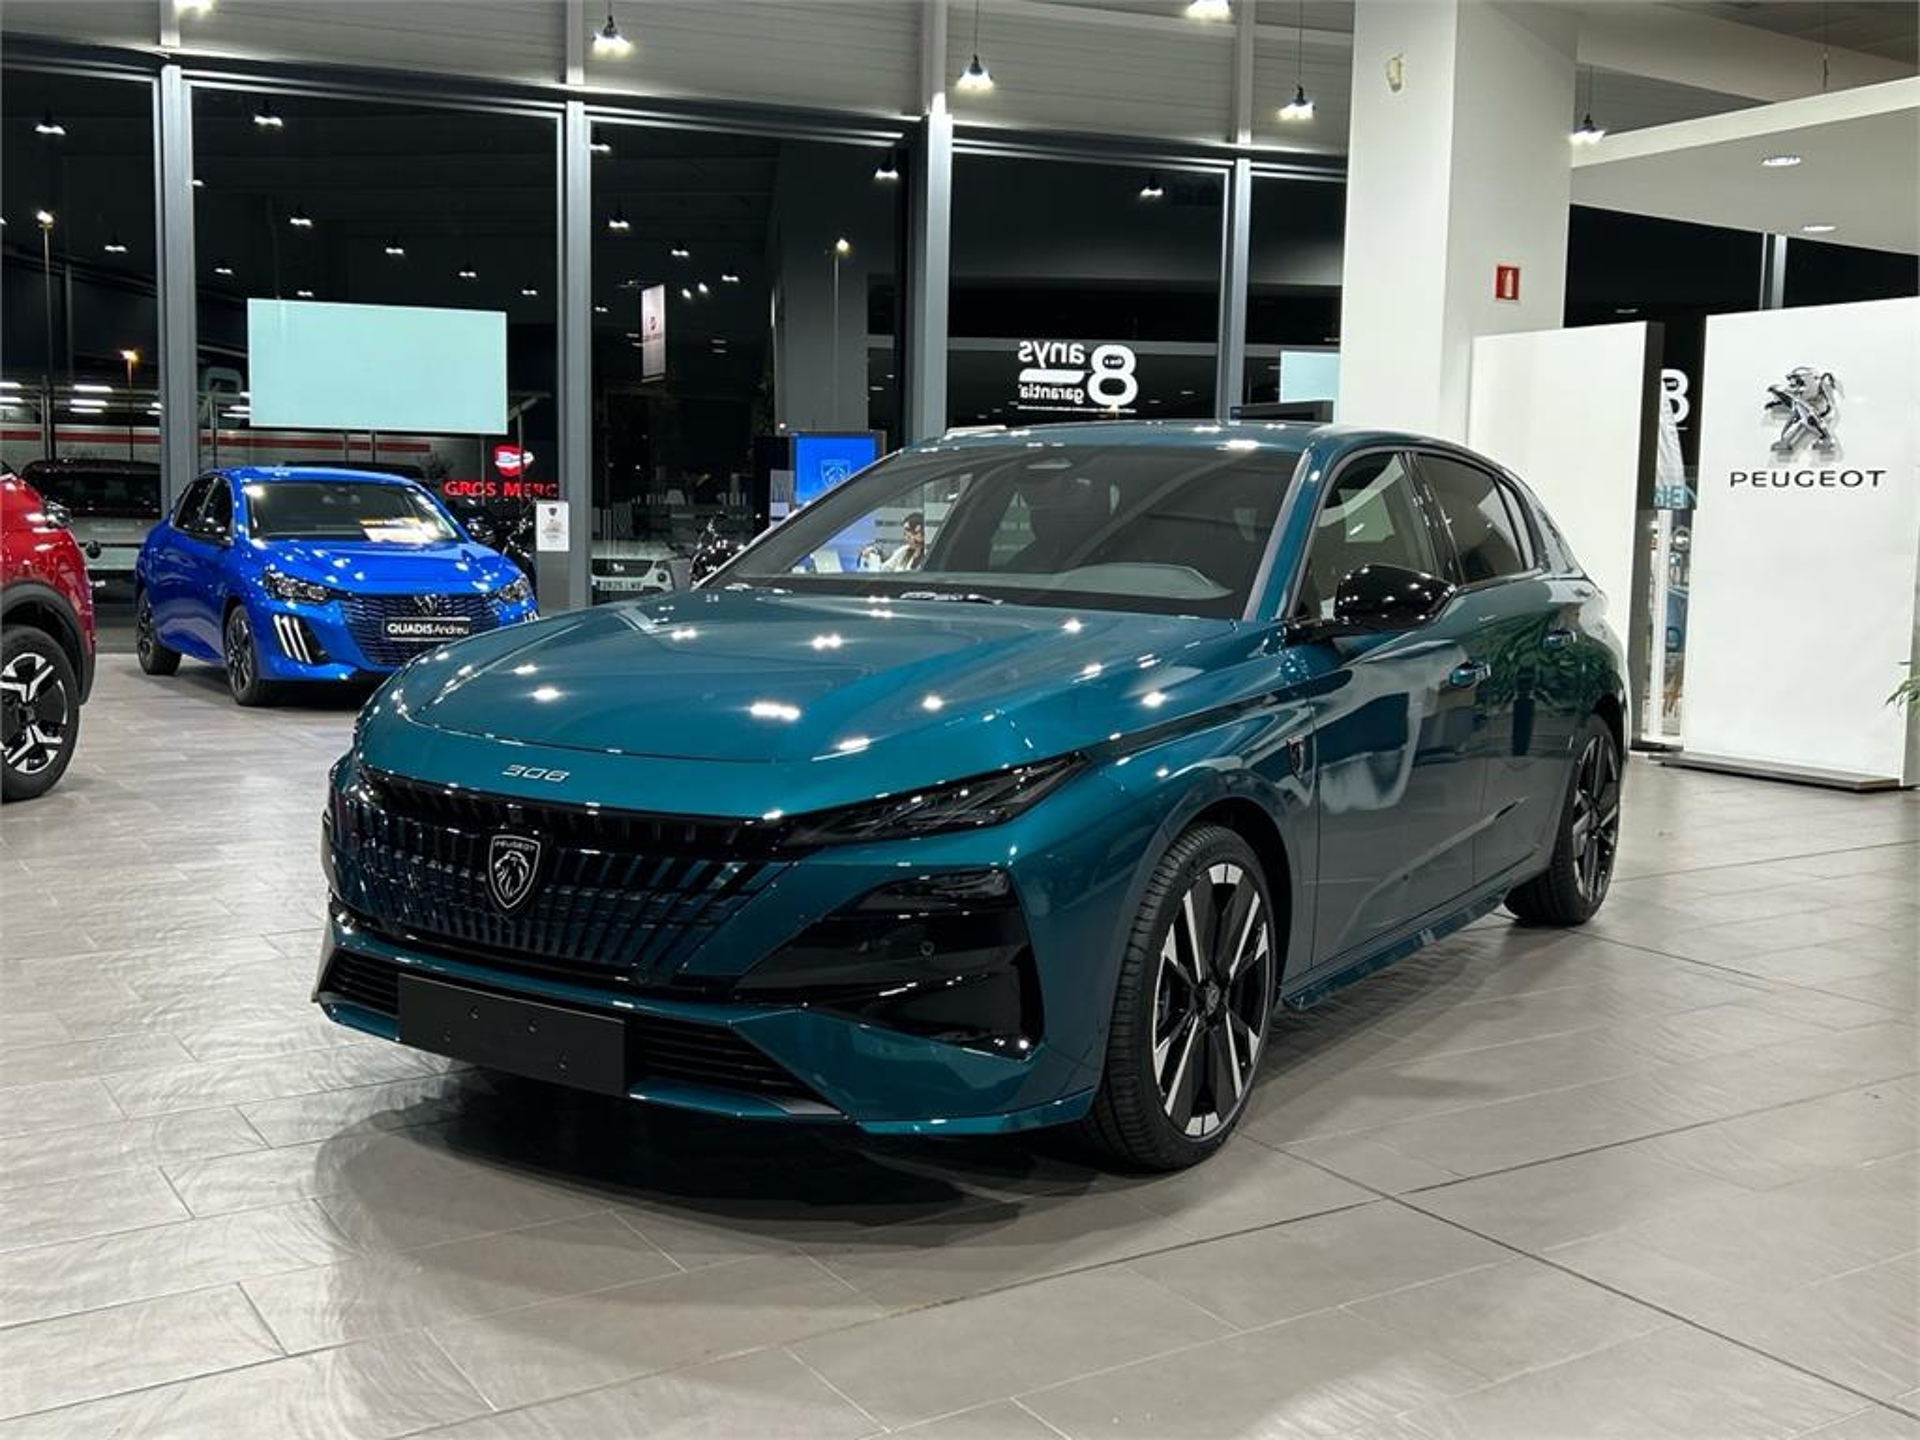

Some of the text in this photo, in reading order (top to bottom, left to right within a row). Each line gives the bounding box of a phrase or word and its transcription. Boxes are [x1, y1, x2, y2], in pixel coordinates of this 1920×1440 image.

[1729, 470, 1887, 488] PEUGEOT
[444, 481, 497, 497] GROS
[502, 765, 570, 782] 308
[495, 840, 536, 853] PEUGEOT
